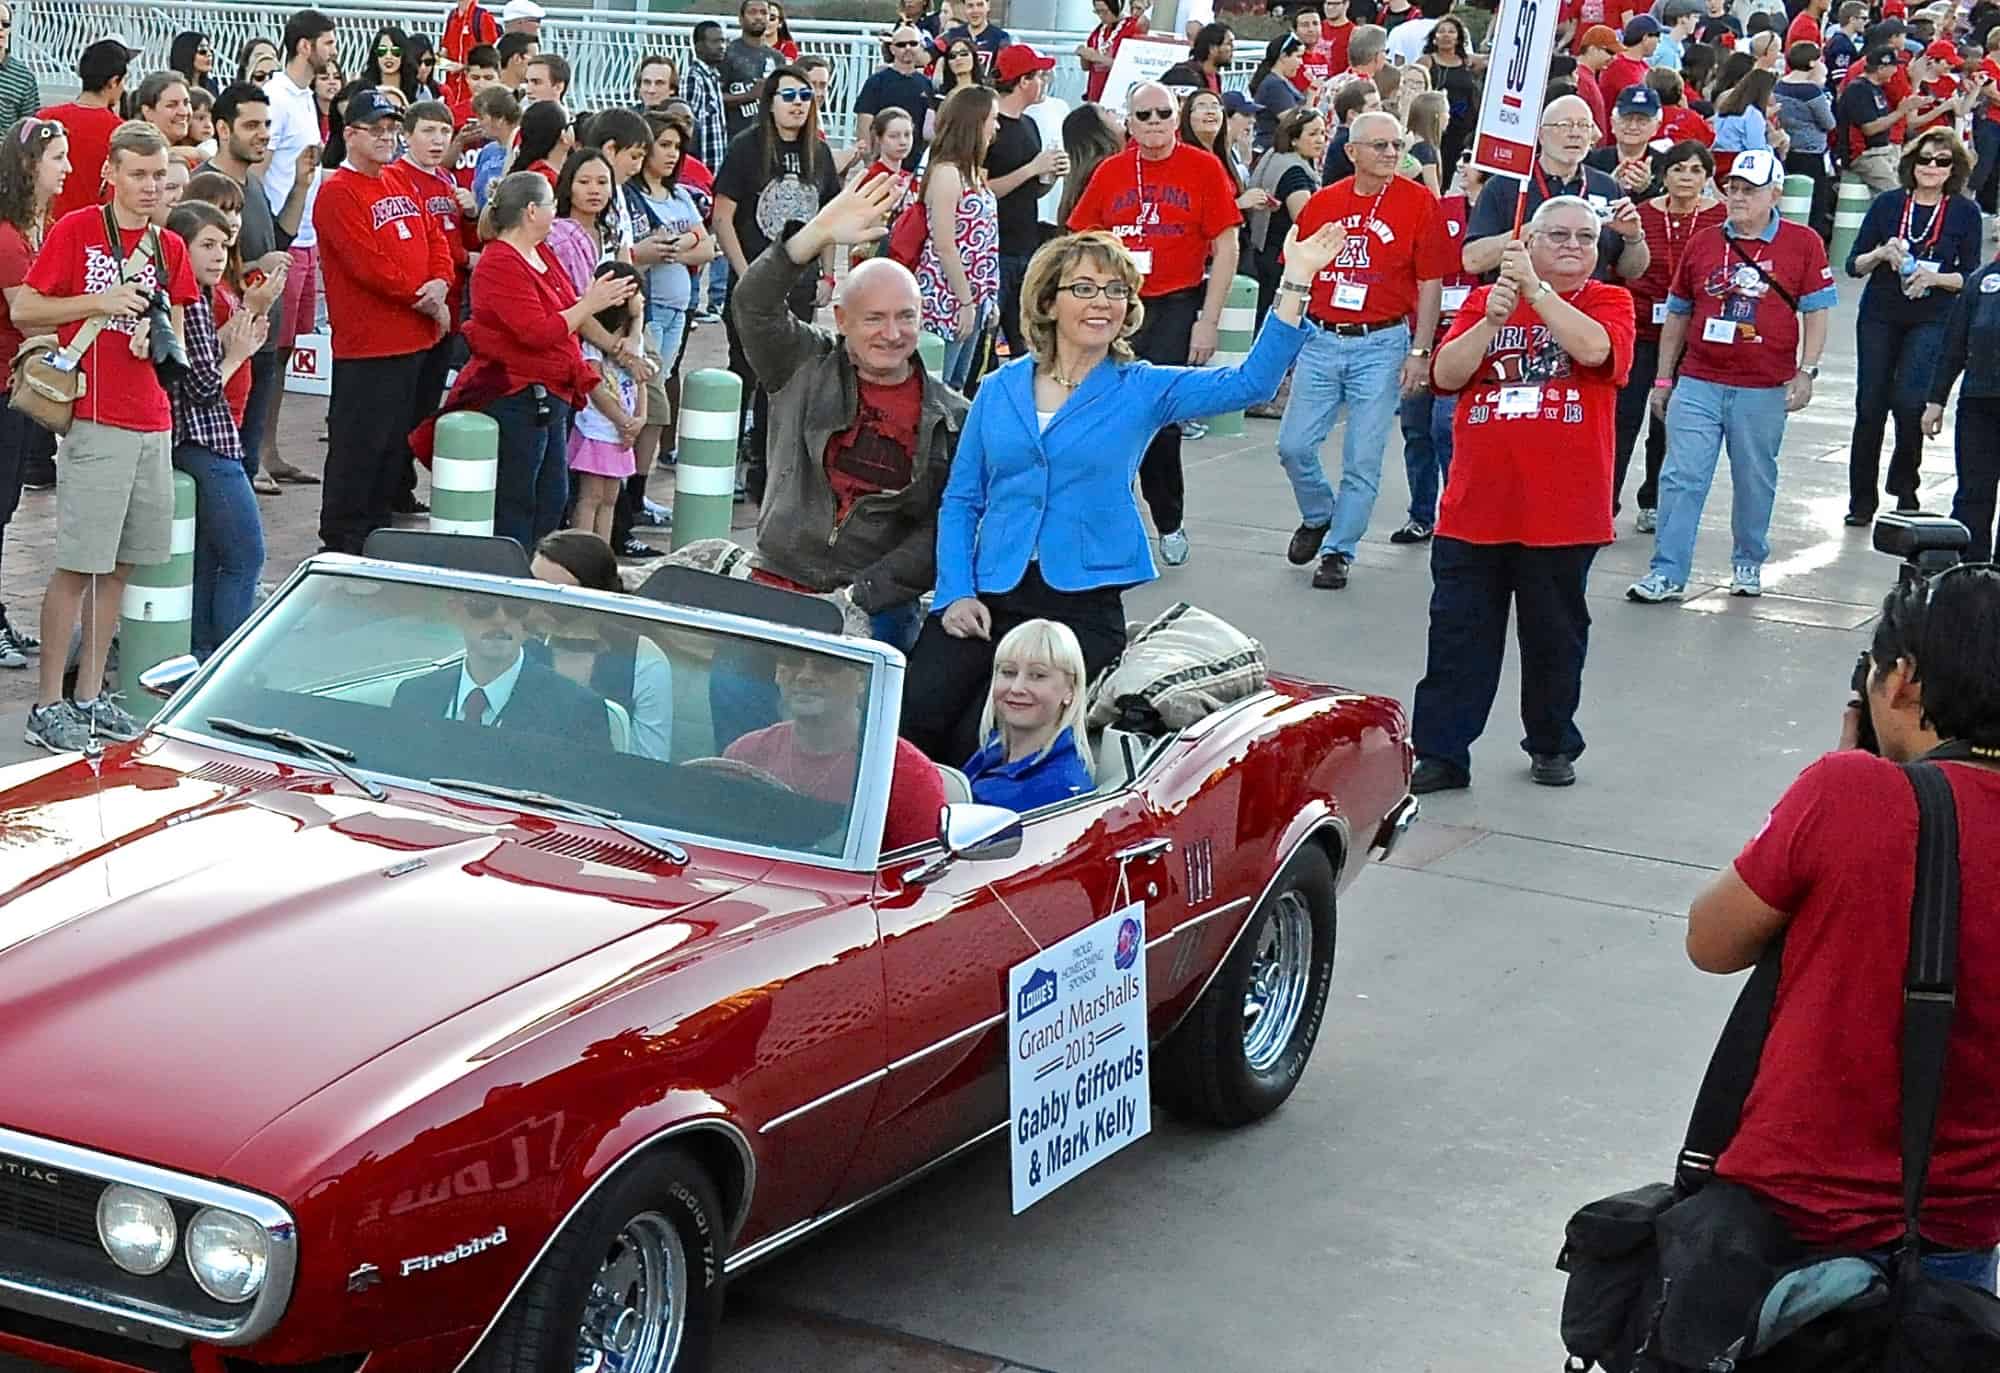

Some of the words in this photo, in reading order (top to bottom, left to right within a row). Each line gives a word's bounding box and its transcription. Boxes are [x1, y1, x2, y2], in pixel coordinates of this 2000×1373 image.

[1507, 0, 1537, 92] 50
[1335, 236, 1371, 268] A
[1320, 271, 1346, 283] EAR
[298, 352, 312, 369] K
[1019, 1010, 1064, 1060] Grand
[1069, 974, 1139, 1034] Marshalls
[1021, 979, 1055, 1018] LOWE'S
[1066, 1031, 1095, 1070] 2013
[1018, 1089, 1070, 1145] Gabby
[1075, 1044, 1143, 1109] Giffords
[1029, 1149, 1041, 1187] &
[1047, 1120, 1090, 1177] Mark
[1095, 1095, 1136, 1147] Kelly
[0, 1162, 58, 1184] TIAC
[400, 1225, 508, 1276] Firebird
